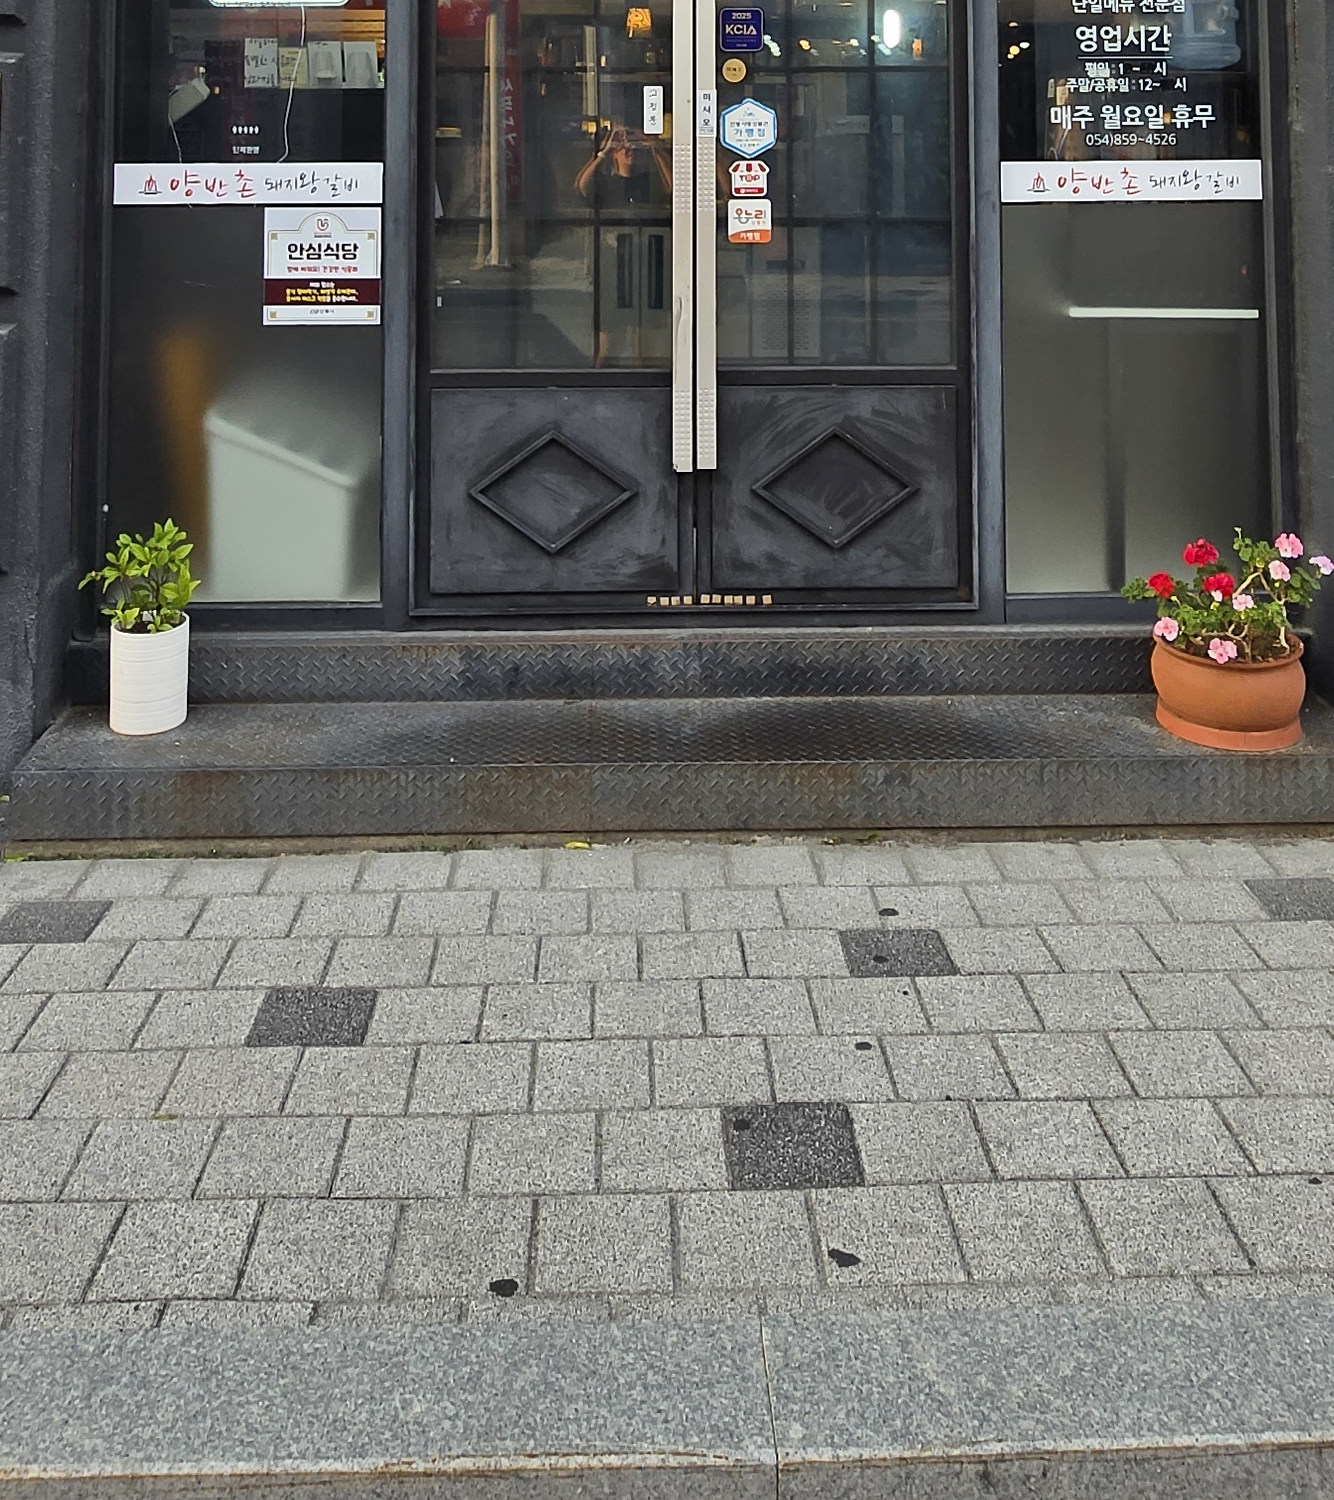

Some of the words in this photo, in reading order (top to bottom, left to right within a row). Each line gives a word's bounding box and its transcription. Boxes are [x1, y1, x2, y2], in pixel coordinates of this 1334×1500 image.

[725, 24, 757, 35] KCIA
[1075, 25, 1172, 52] 영업시간
[702, 93, 711, 126] 미시오
[1050, 105, 1094, 130] 매주
[1100, 104, 1164, 130] 월요일
[1171, 104, 1216, 130] 휴무
[170, 169, 257, 197] 양반촌
[265, 171, 359, 197] 돼지왕갈비
[1058, 167, 1142, 195] 양반촌
[1149, 169, 1240, 194] 돼지왕갈비
[287, 243, 359, 260] 안심식당
